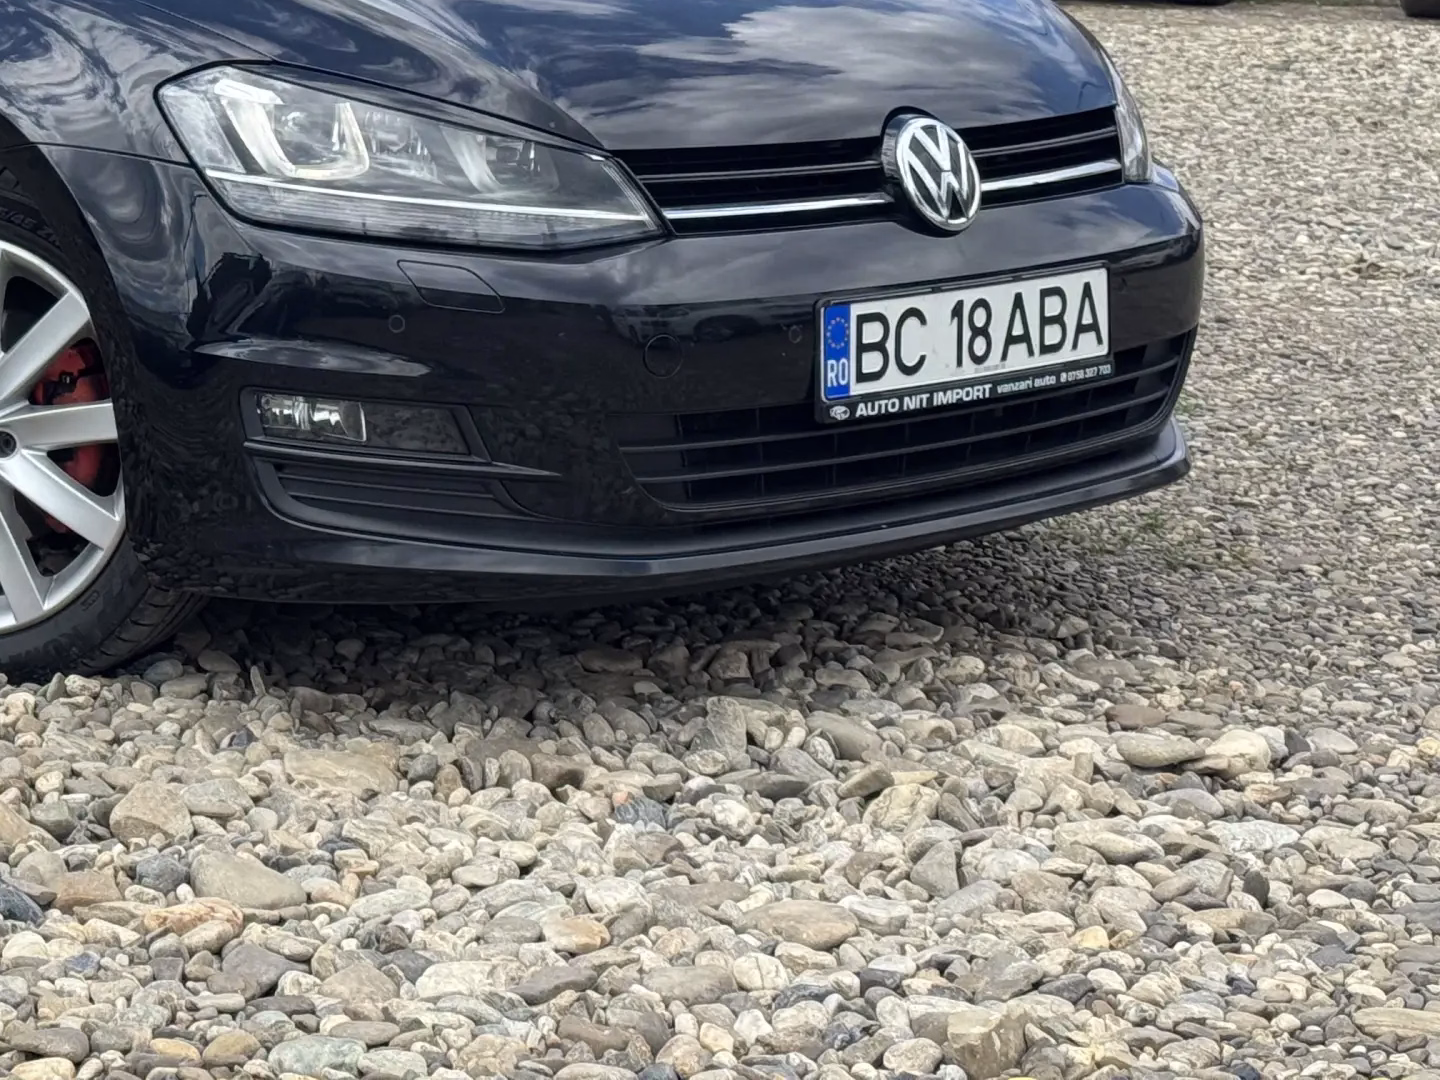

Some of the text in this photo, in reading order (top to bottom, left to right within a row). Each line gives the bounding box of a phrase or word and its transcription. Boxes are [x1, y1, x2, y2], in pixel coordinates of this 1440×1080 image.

[855, 307, 927, 384] BC
[826, 358, 849, 388] RO
[855, 398, 900, 419] AUTO
[903, 392, 931, 411] NIT
[933, 383, 993, 407] IMPORT
[997, 377, 1033, 395] vanzari
[1034, 375, 1057, 388] auto
[1085, 366, 1098, 379] 327
